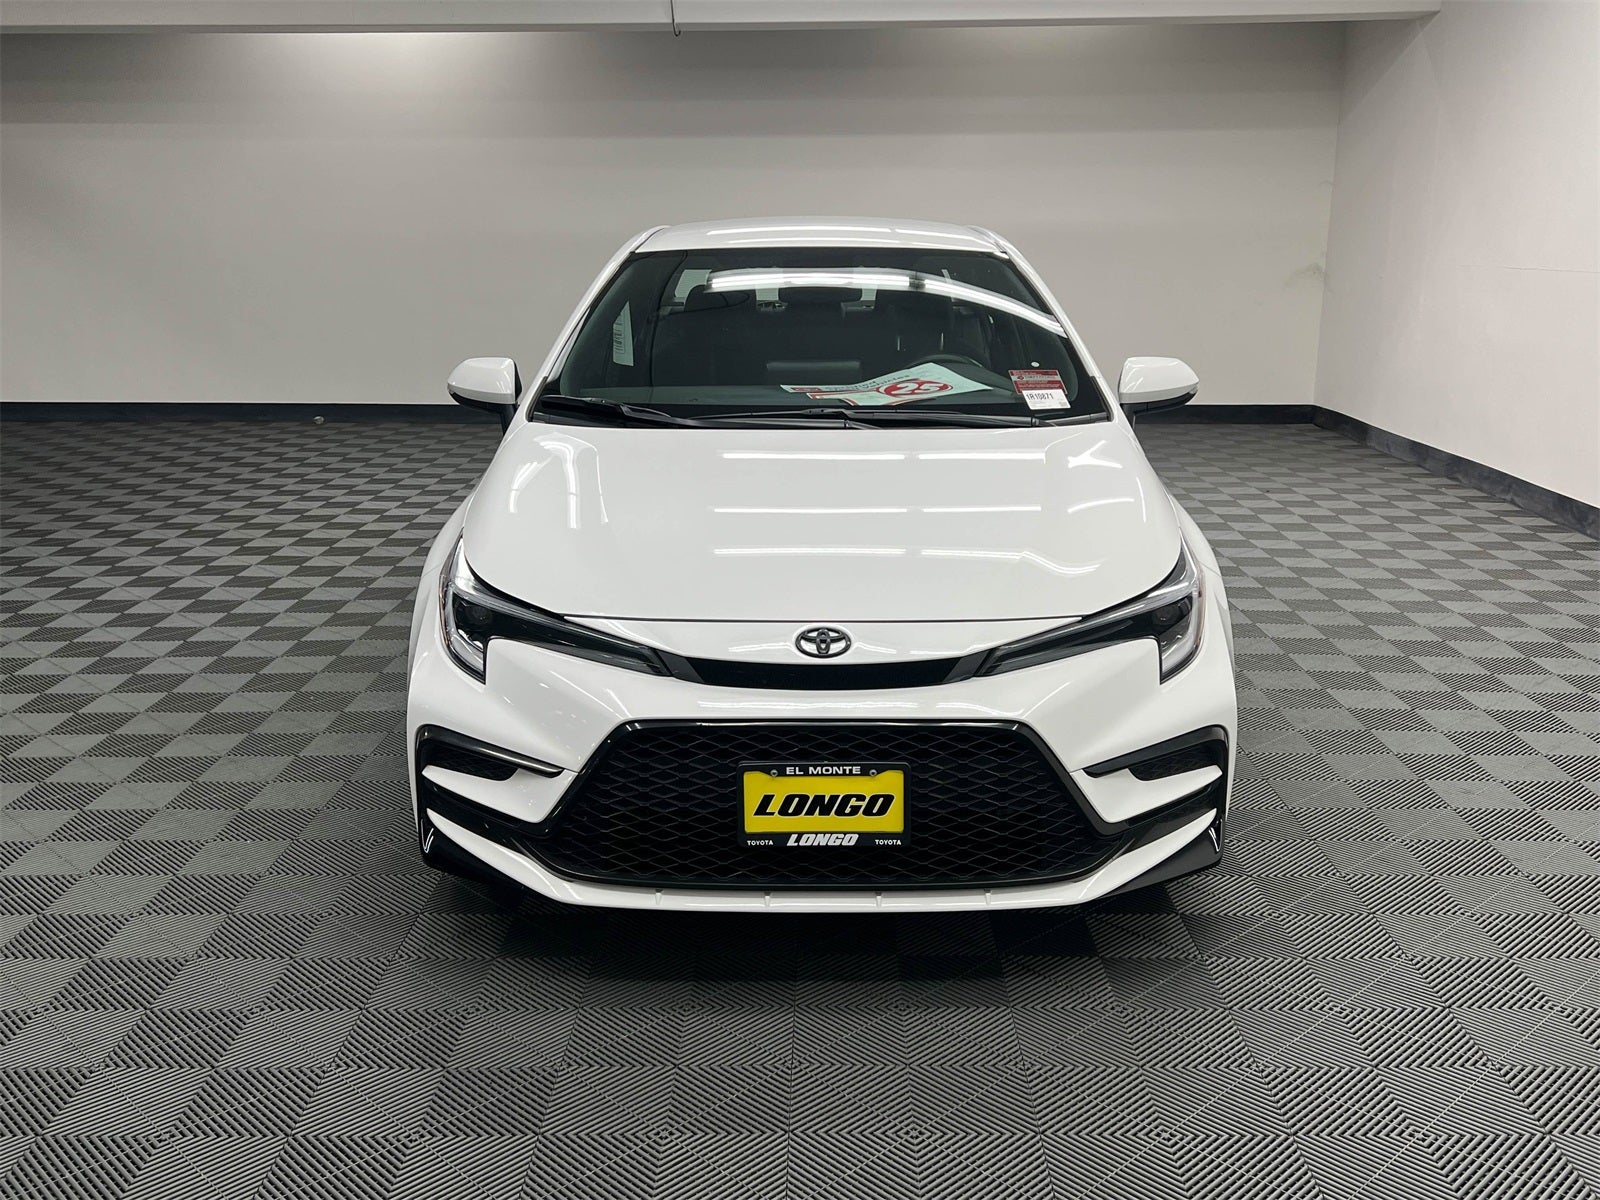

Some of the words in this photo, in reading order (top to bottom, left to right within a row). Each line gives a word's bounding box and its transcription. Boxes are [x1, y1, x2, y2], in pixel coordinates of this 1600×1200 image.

[890, 382, 944, 395] 25
[786, 766, 804, 775] EL
[808, 766, 861, 775] MONTE
[753, 793, 895, 818] LONGO
[786, 833, 859, 847] LONGO
